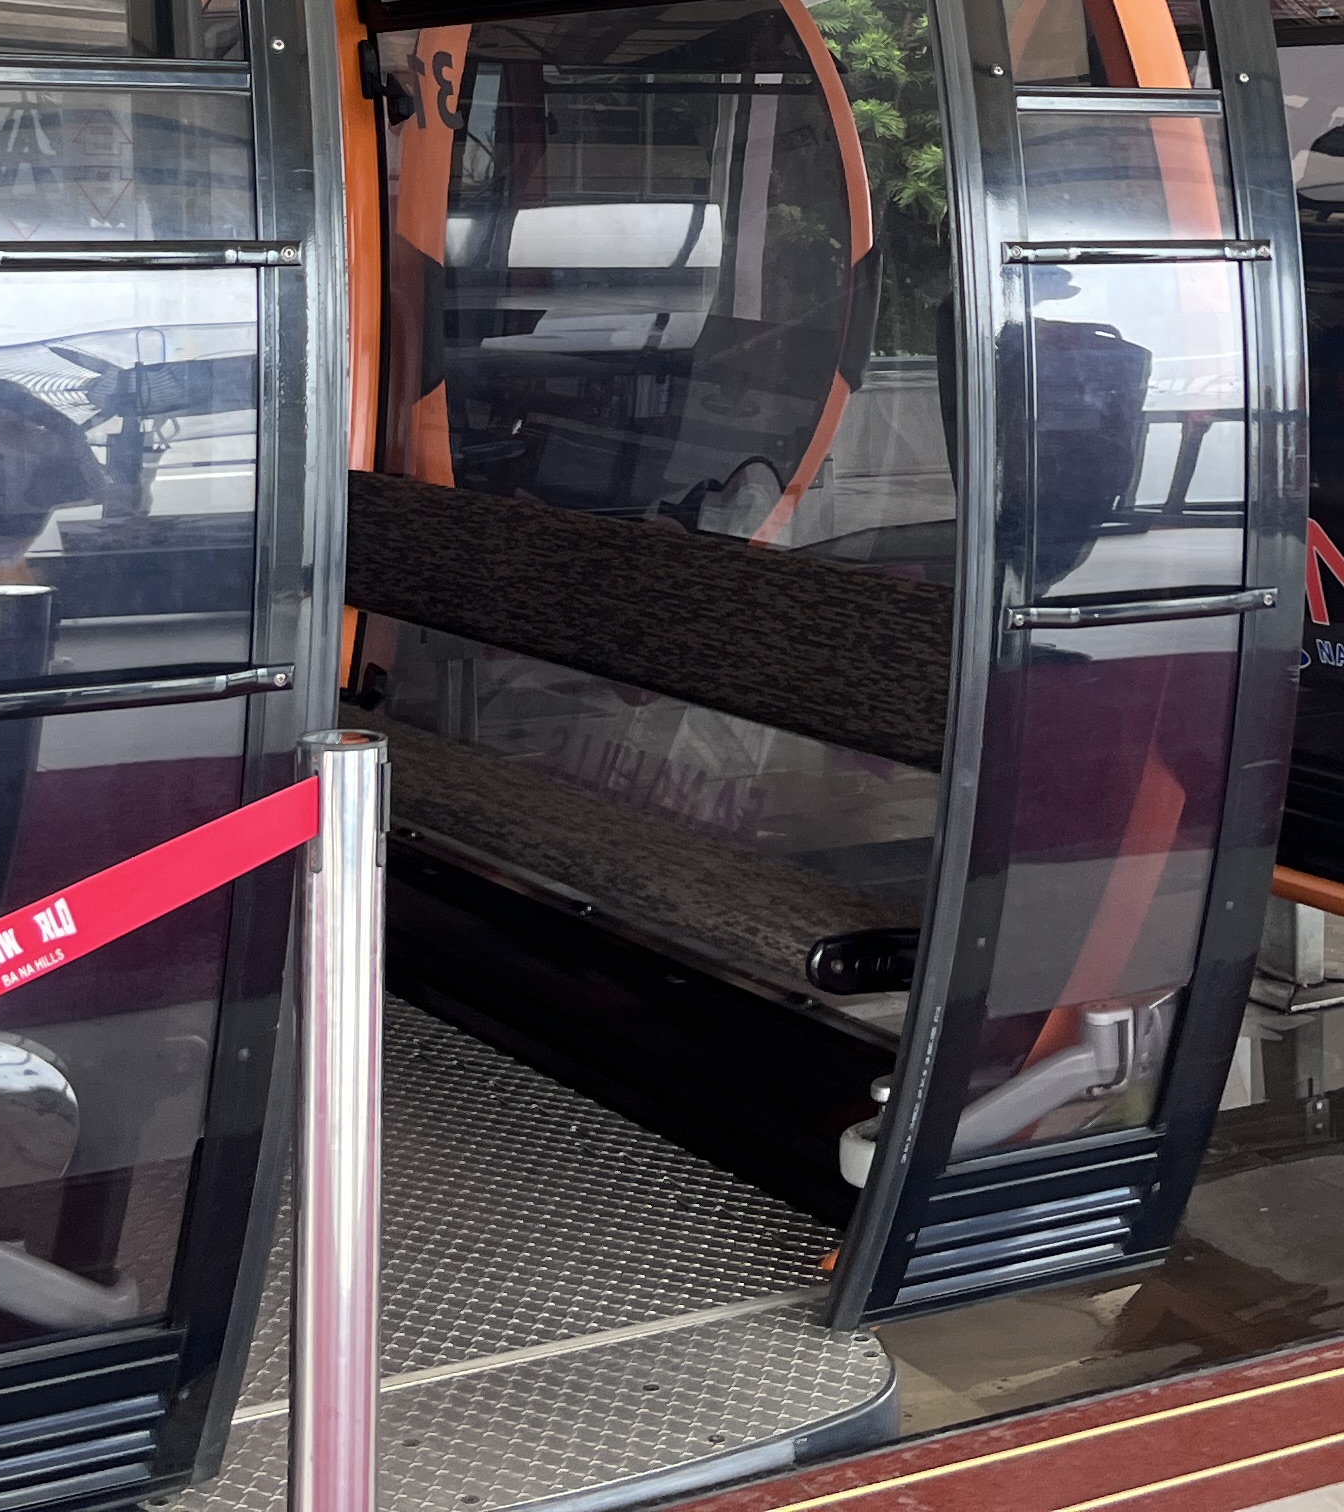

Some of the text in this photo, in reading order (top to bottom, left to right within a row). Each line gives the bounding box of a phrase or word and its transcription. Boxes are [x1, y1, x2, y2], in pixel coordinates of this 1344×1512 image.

[1, 948, 65, 987] BA NA HILLS
